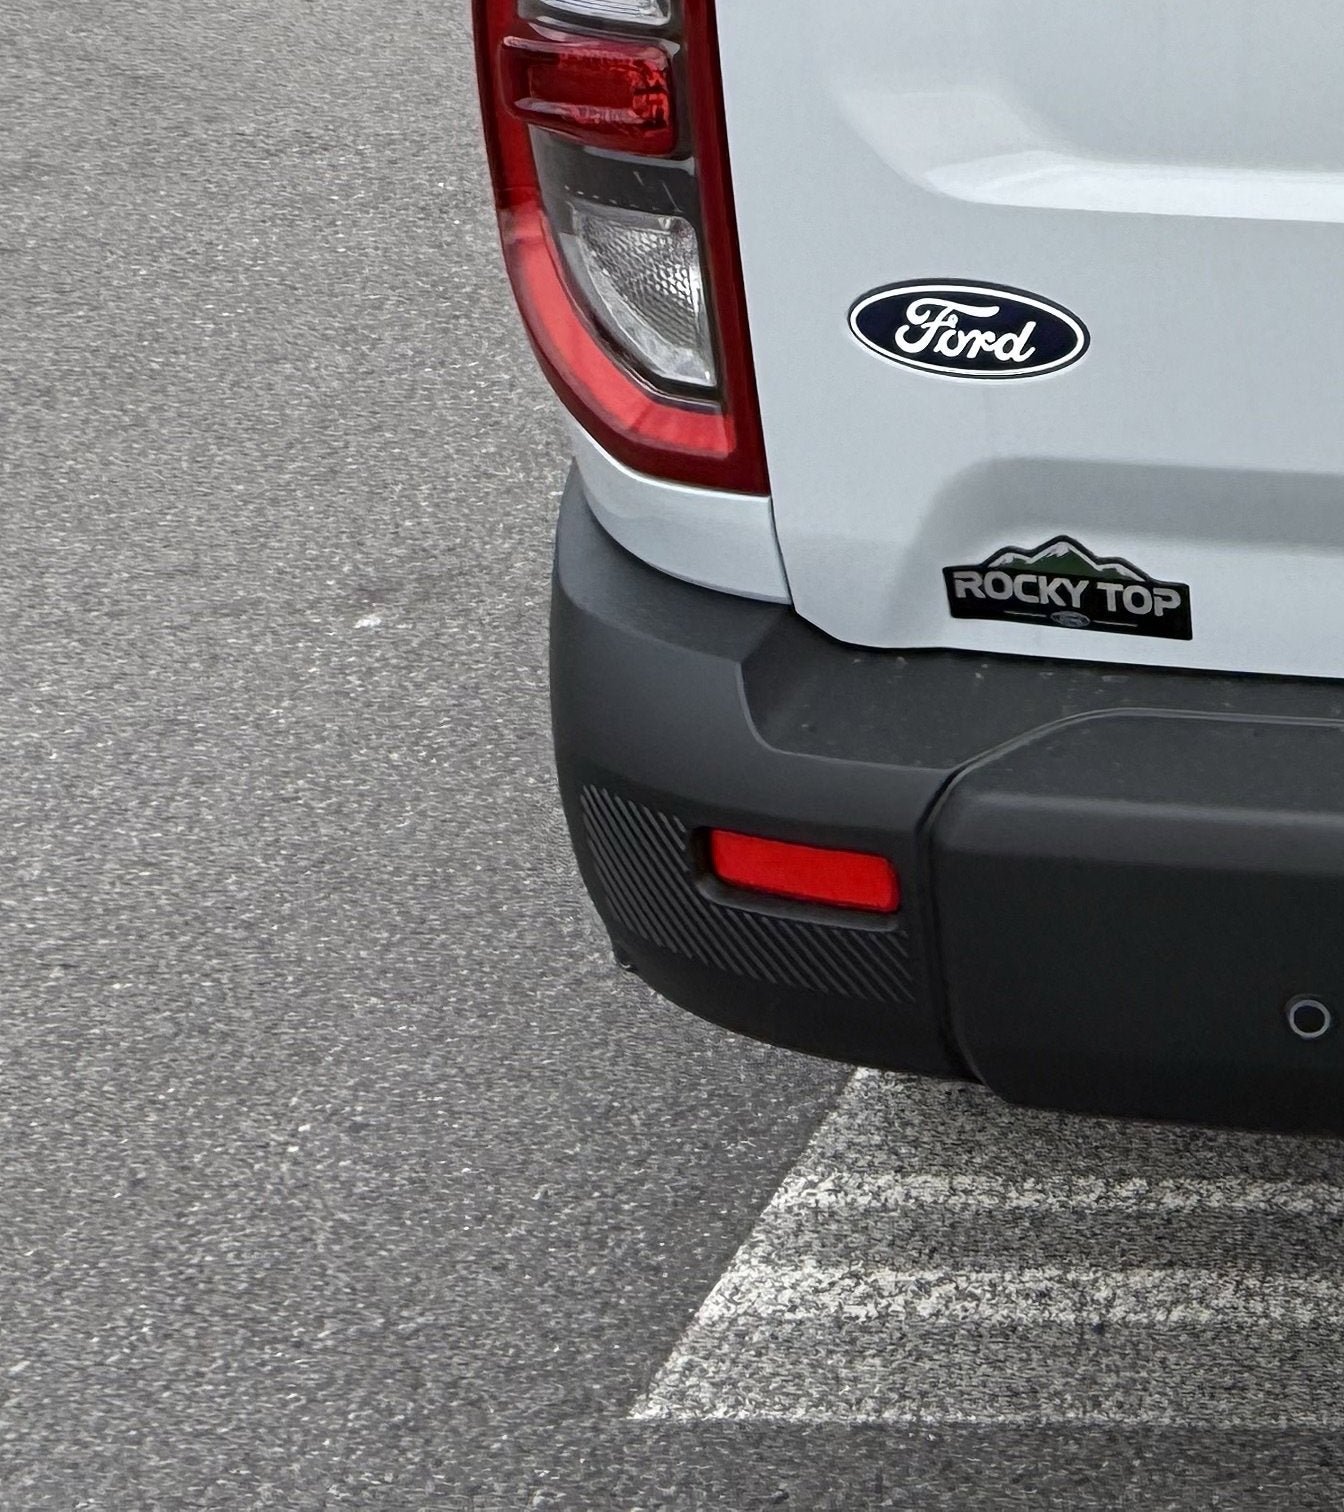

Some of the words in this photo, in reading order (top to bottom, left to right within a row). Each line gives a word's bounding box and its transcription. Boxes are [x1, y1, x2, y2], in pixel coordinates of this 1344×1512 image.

[894, 297, 1038, 363] Ford
[953, 570, 1091, 609] ROCKY
[1096, 582, 1182, 617] TOP
